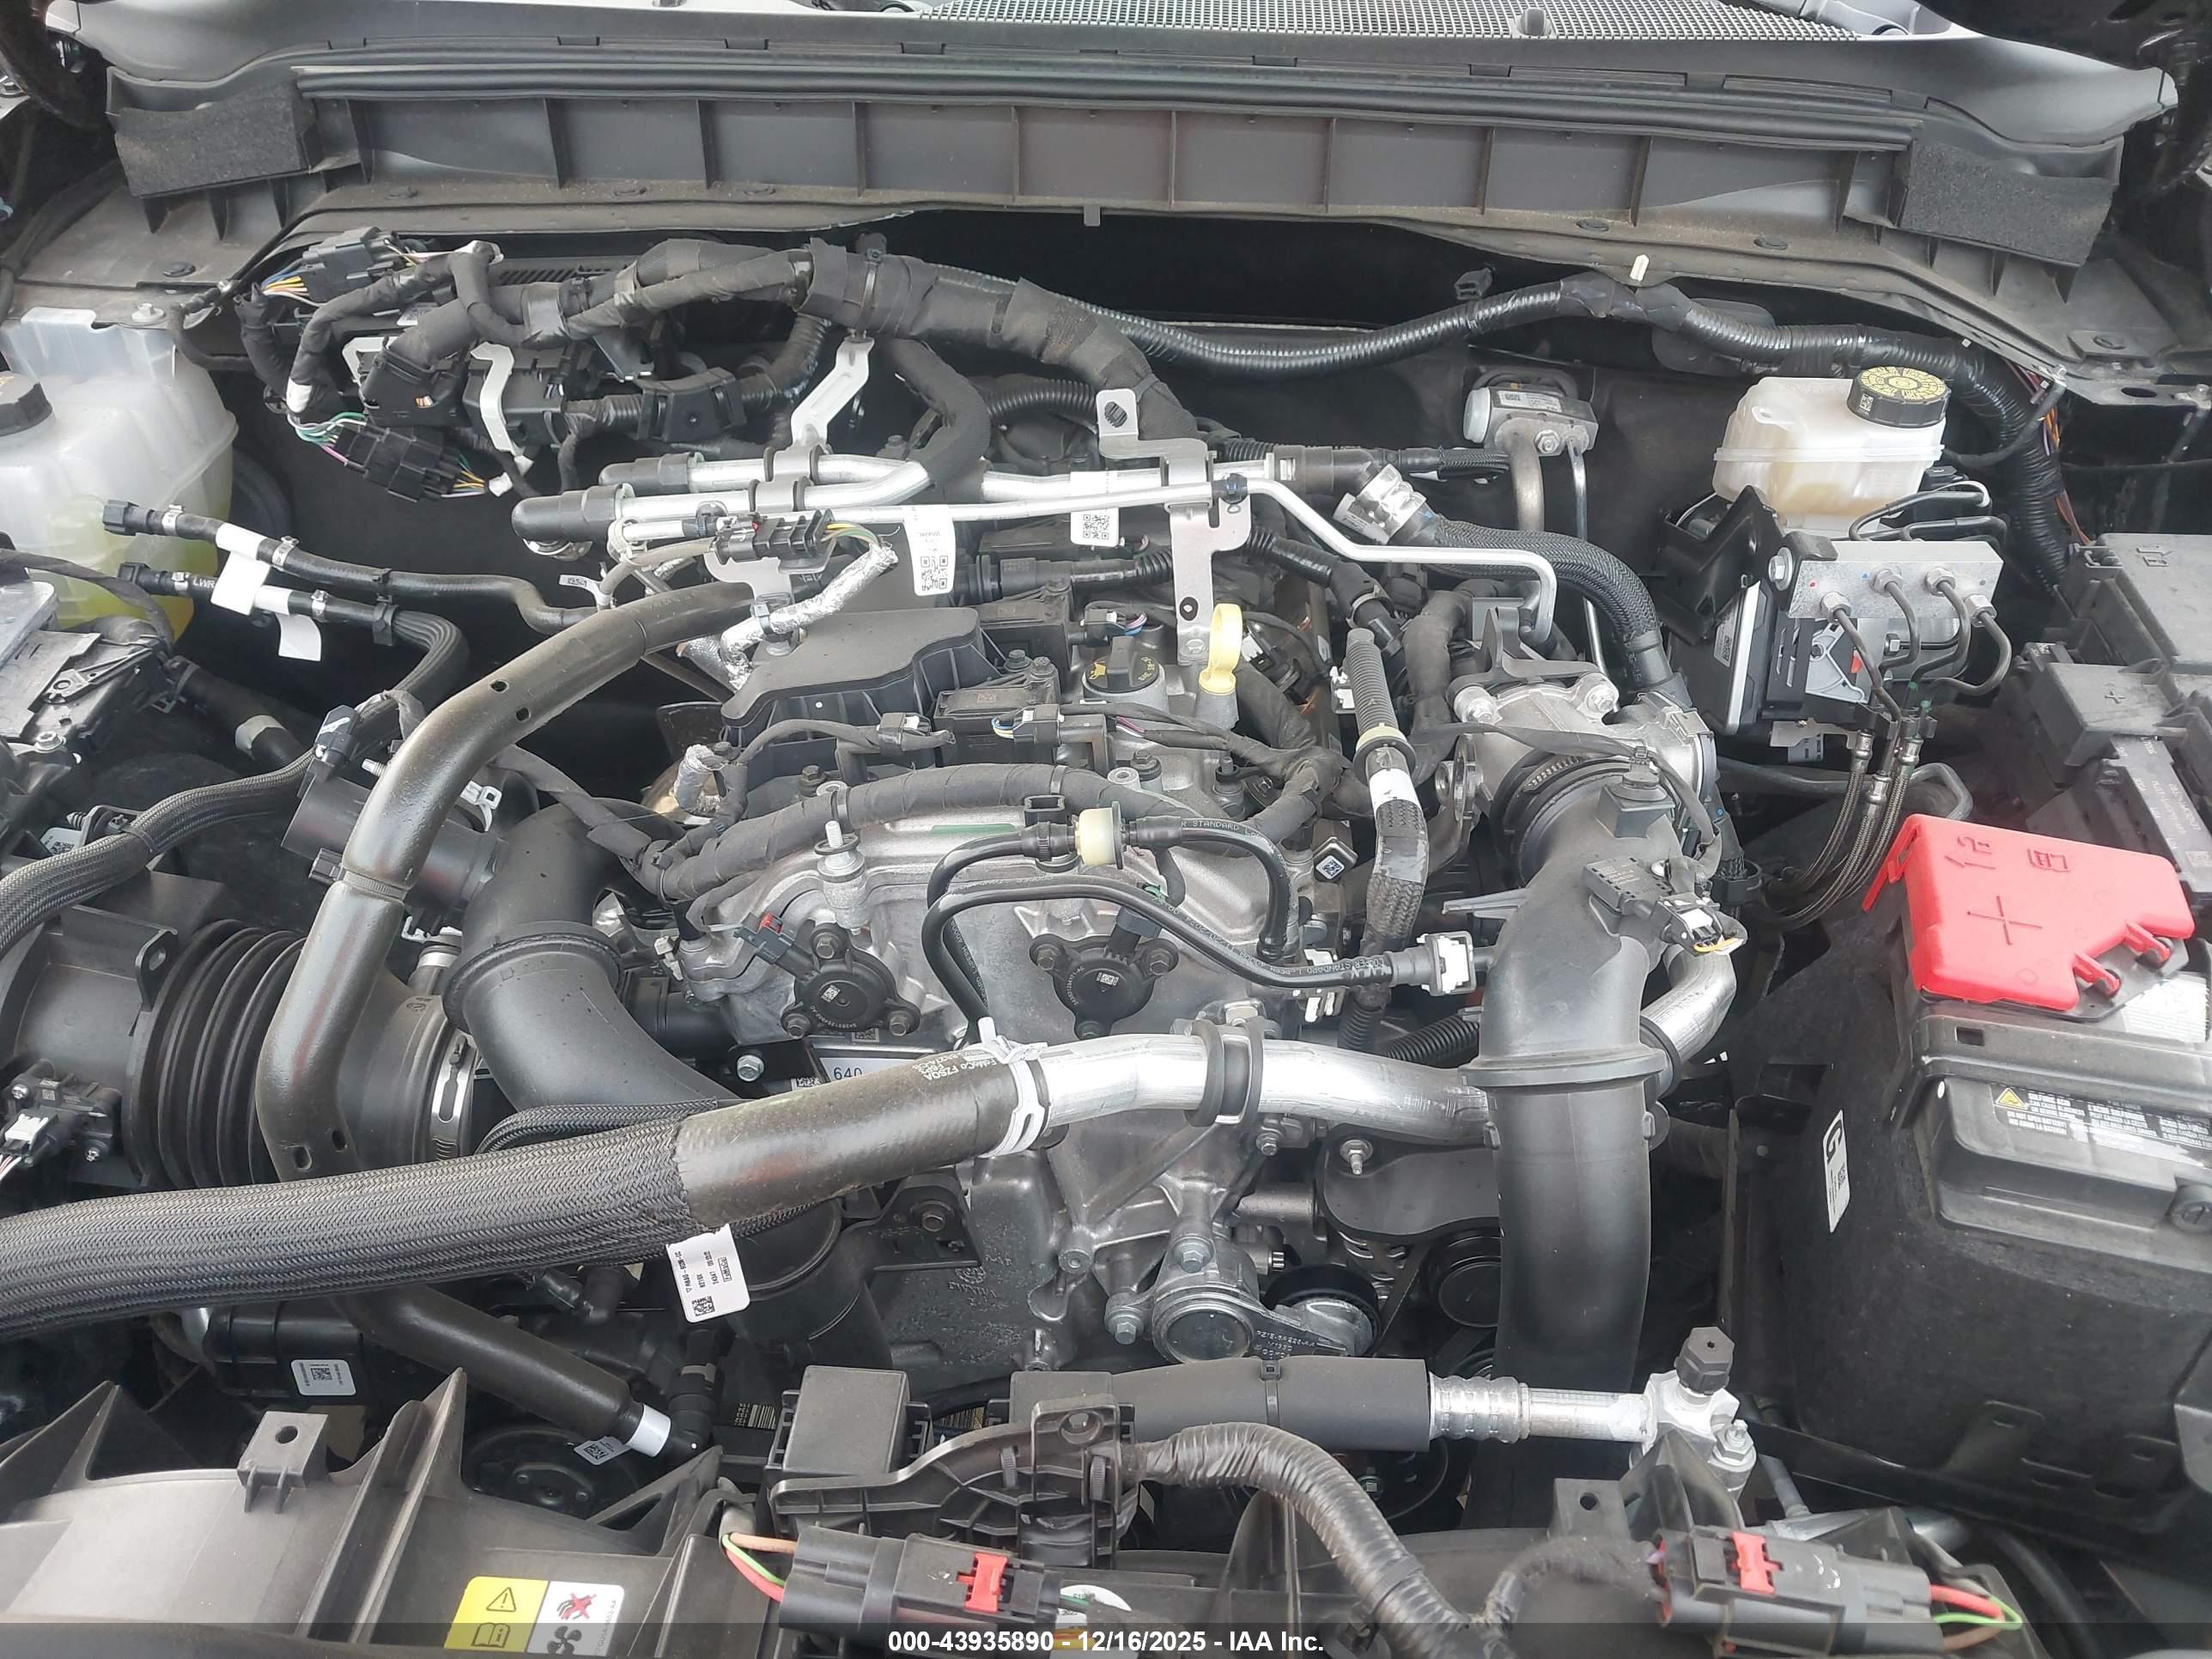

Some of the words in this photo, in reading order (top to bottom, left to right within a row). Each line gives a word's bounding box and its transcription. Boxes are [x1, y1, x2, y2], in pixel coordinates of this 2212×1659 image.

[1192, 819, 1240, 831] STANDARD
[1306, 960, 1351, 974] STANDARD
[834, 1066, 863, 1080] 640
